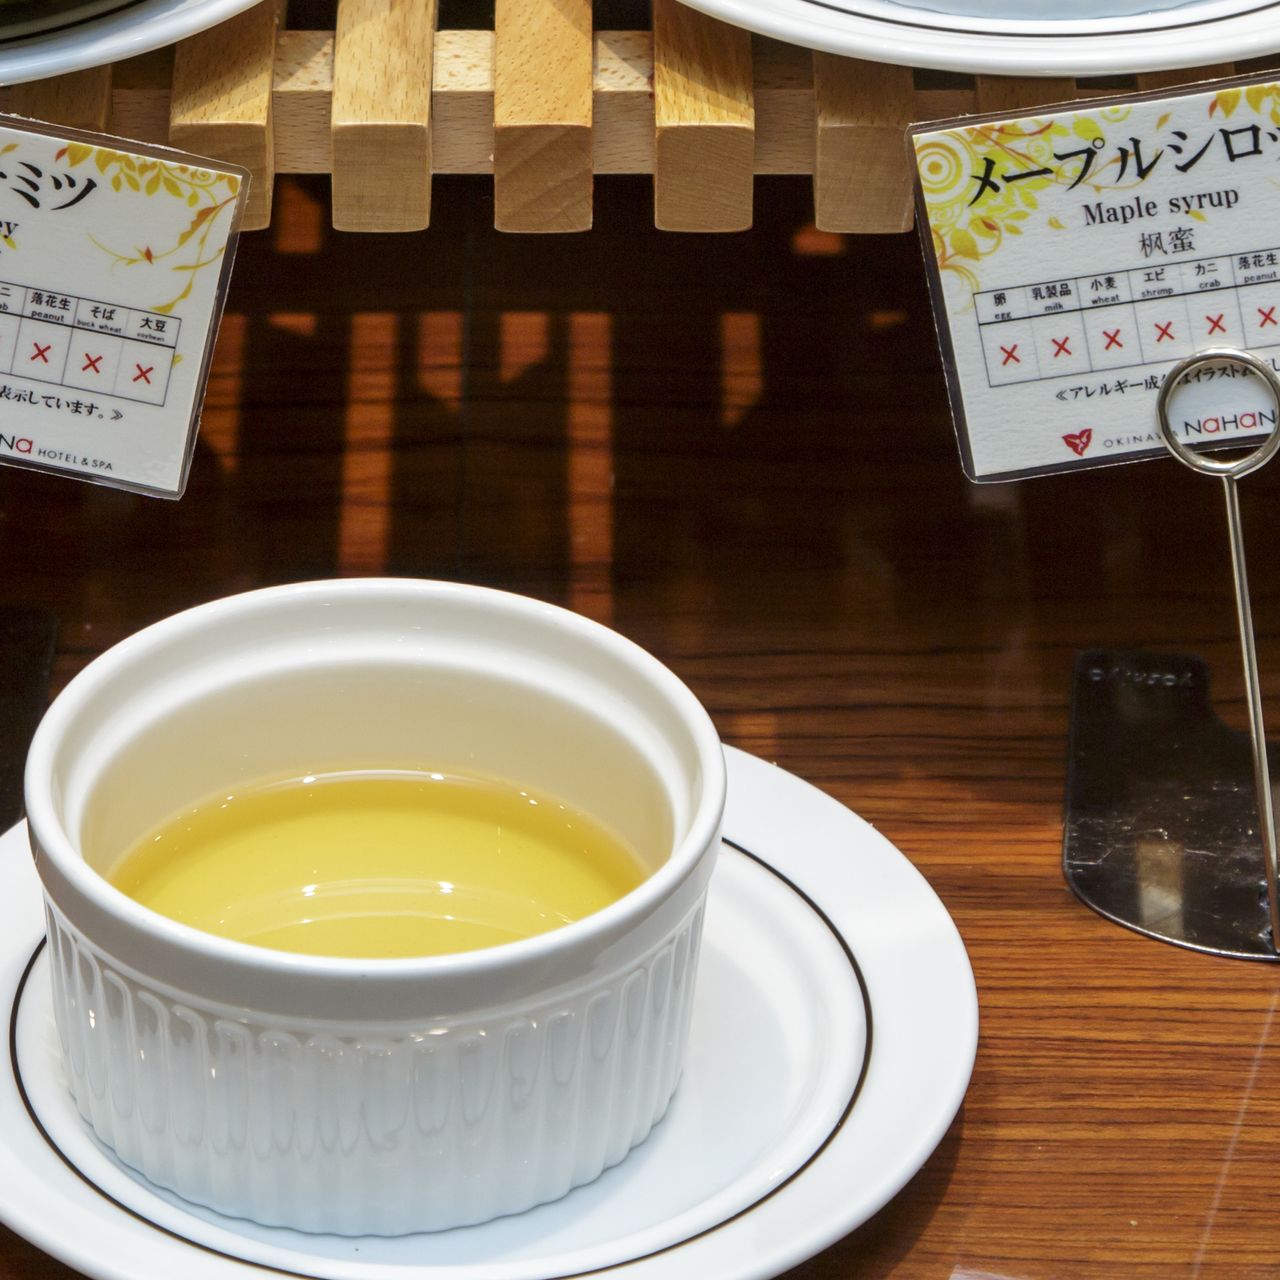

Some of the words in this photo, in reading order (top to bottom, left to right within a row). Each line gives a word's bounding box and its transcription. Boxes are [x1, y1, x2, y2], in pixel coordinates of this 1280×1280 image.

[1082, 193, 1158, 228] Maple
[1169, 185, 1240, 218] syrup
[1138, 226, 1197, 258] 枫蜜
[993, 292, 1007, 306] 卵
[1031, 283, 1072, 301] 乳製品
[1090, 276, 1118, 291] 小麦
[1144, 268, 1166, 282] エビ
[1194, 262, 1218, 276] カニ
[1238, 253, 1279, 270] 落花生
[1044, 302, 1064, 312] milk
[1091, 294, 1120, 305] wheat
[1141, 286, 1174, 298] shrimp
[1199, 280, 1221, 290] crab
[1244, 271, 1277, 284] peanut
[30, 291, 71, 311] 落花生
[90, 306, 115, 321] そば
[140, 317, 167, 333] 大豆
[31, 309, 65, 323] peanut
[99, 323, 122, 333] wheat
[37, 448, 78, 465] HOTEL
[81, 457, 89, 466] &
[91, 457, 113, 471] SPA
